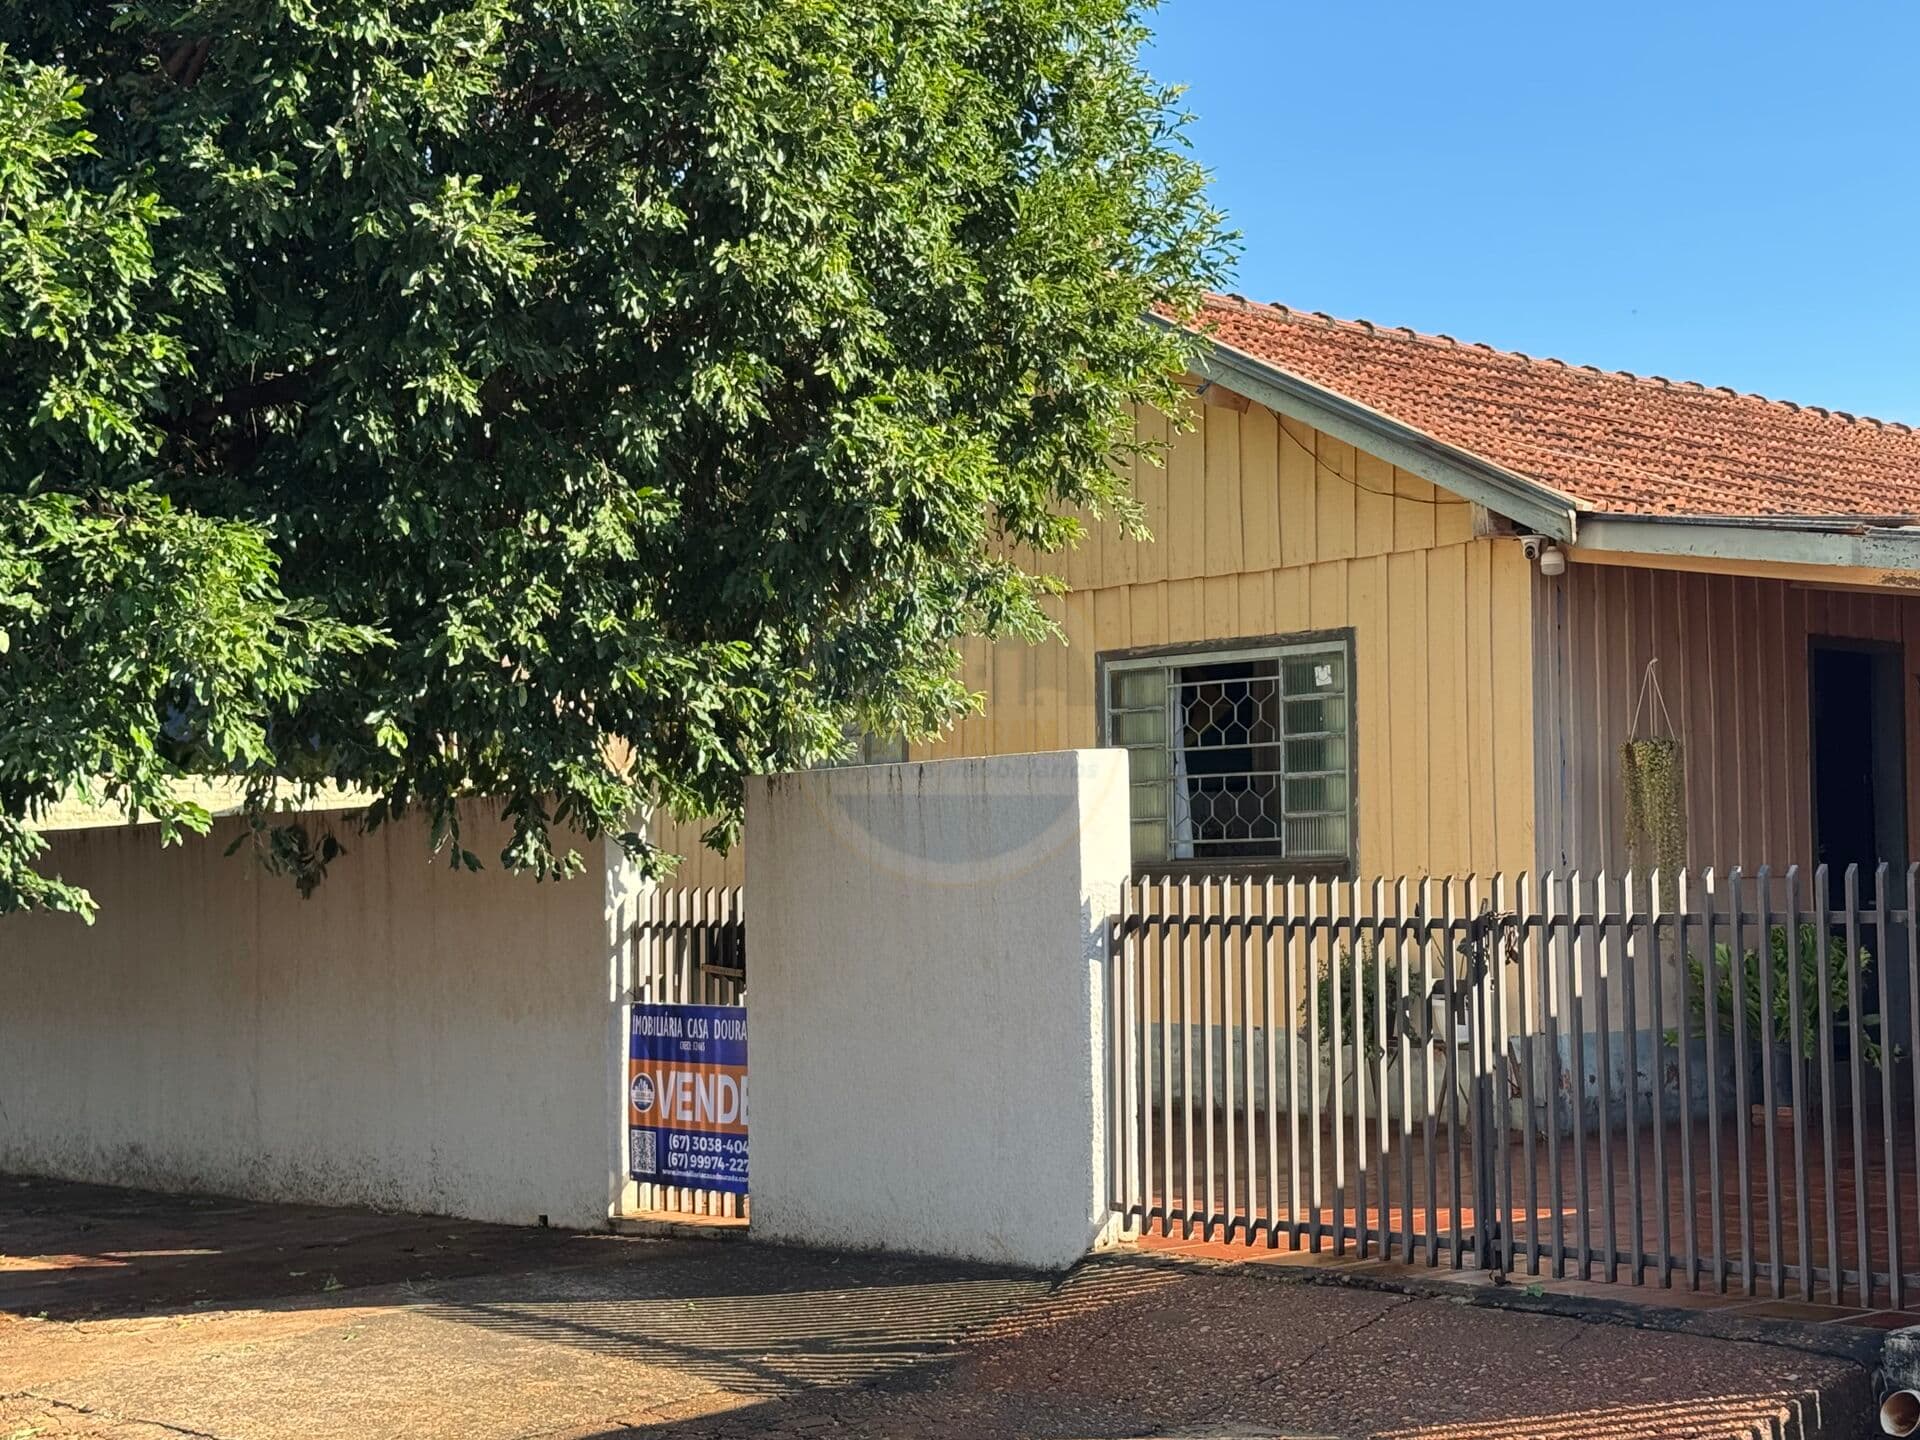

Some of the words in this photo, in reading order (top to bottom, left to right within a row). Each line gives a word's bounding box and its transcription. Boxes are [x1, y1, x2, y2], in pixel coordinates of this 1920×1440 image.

[632, 1011, 683, 1038] IMOBILIÁRIA
[687, 1018, 709, 1039] CASA
[713, 1019, 748, 1041] DOURA
[669, 1133, 690, 1152] (67)
[667, 1151, 688, 1169] (67)
